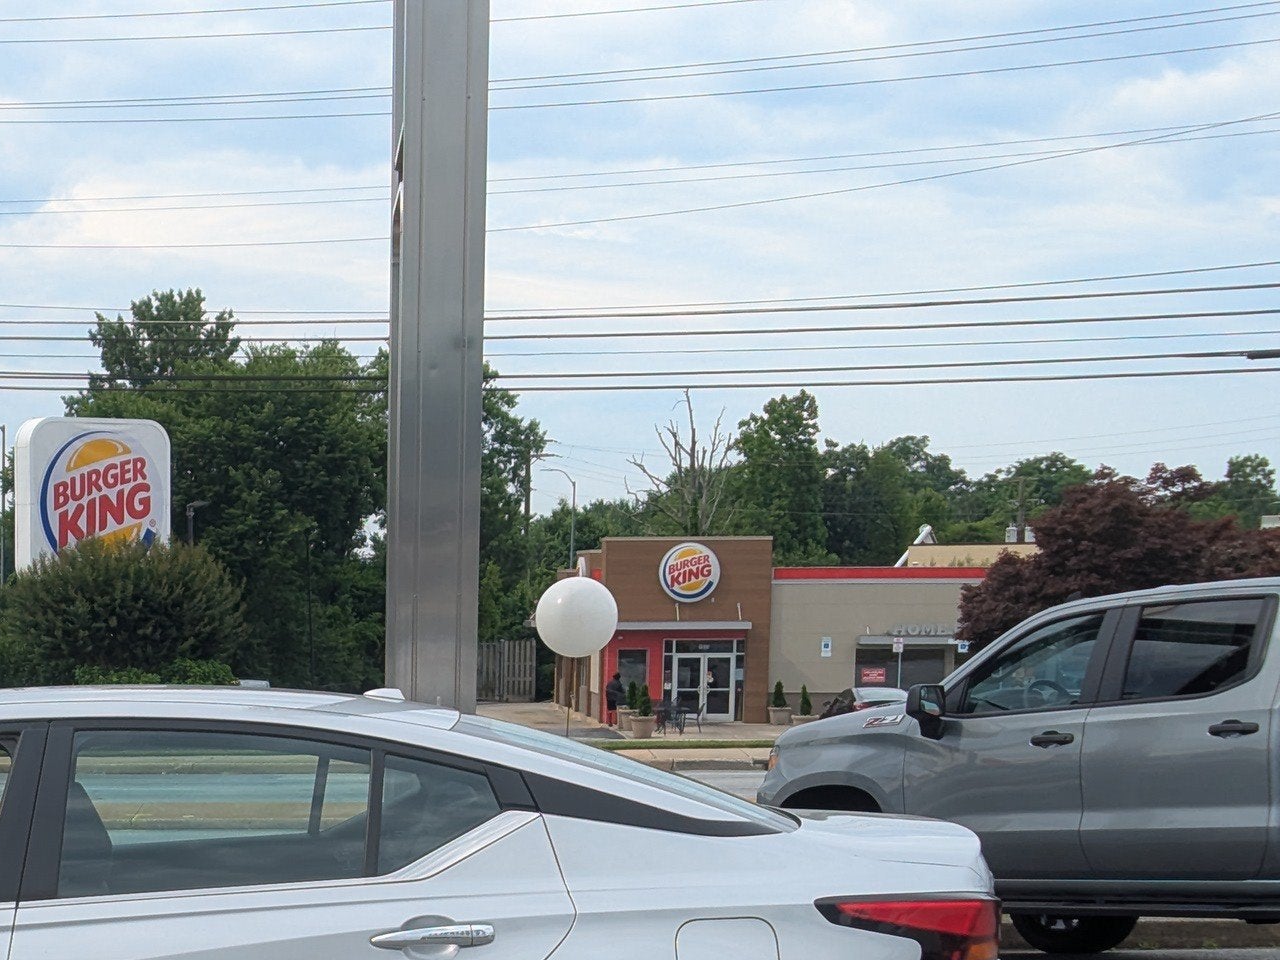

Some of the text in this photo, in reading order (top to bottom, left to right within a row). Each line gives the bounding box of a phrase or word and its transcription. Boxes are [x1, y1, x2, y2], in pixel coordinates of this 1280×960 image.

[53, 457, 147, 511] BURGER
[58, 483, 151, 547] KING
[668, 554, 710, 575] BURGER
[669, 564, 712, 589] KING
